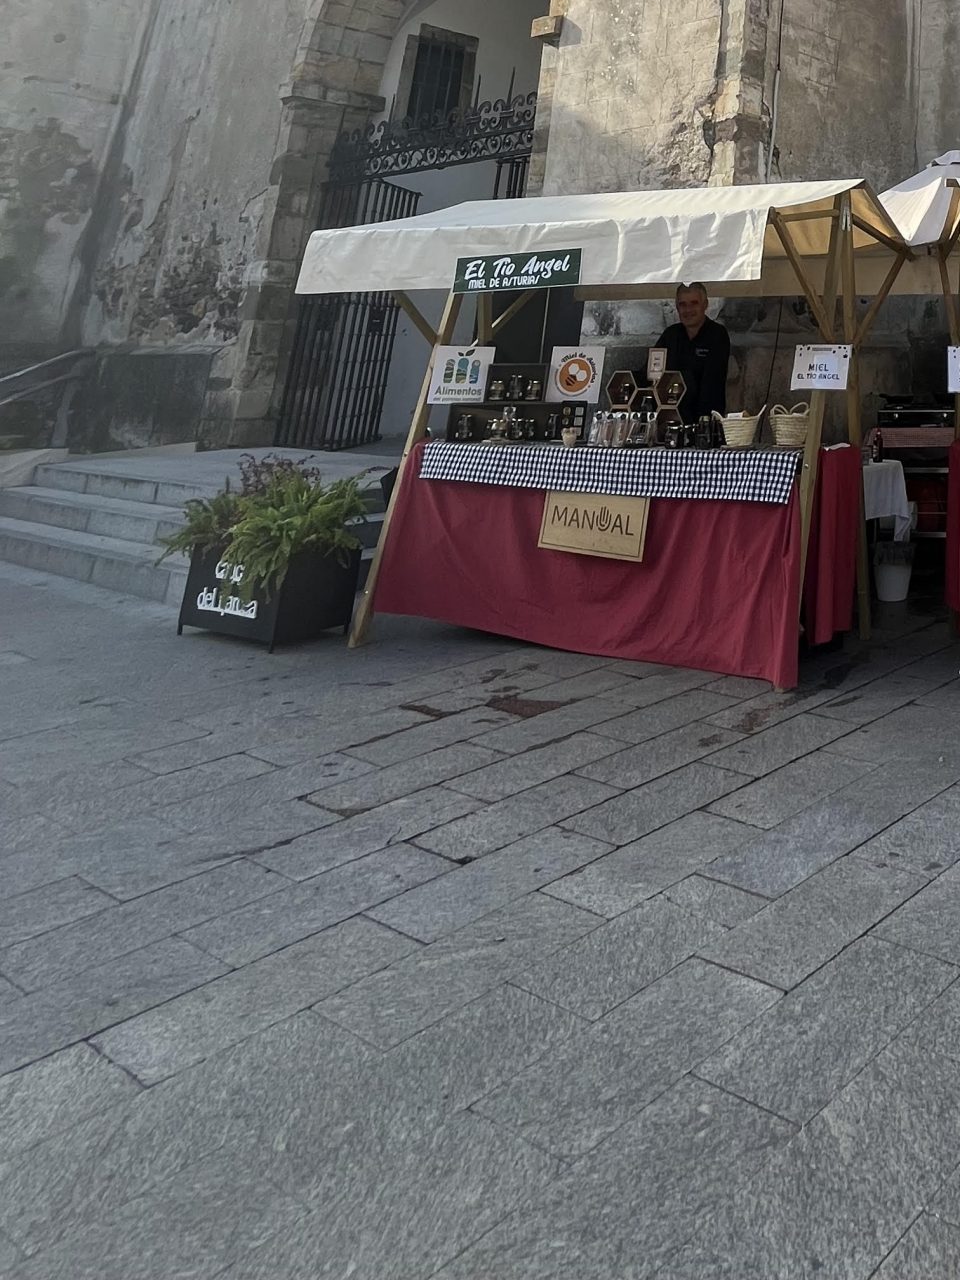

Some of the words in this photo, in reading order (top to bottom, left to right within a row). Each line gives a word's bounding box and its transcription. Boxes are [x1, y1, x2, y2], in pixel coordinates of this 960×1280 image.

[464, 260, 485, 280] El
[520, 255, 570, 278] Angel
[468, 279, 487, 289] MIEL
[490, 278, 500, 288] DE
[502, 275, 540, 286] ASTURIAS
[808, 363, 829, 372] MIEL
[434, 385, 482, 397] Alimentos
[551, 505, 634, 536] MANUAL
[197, 587, 217, 609] del
